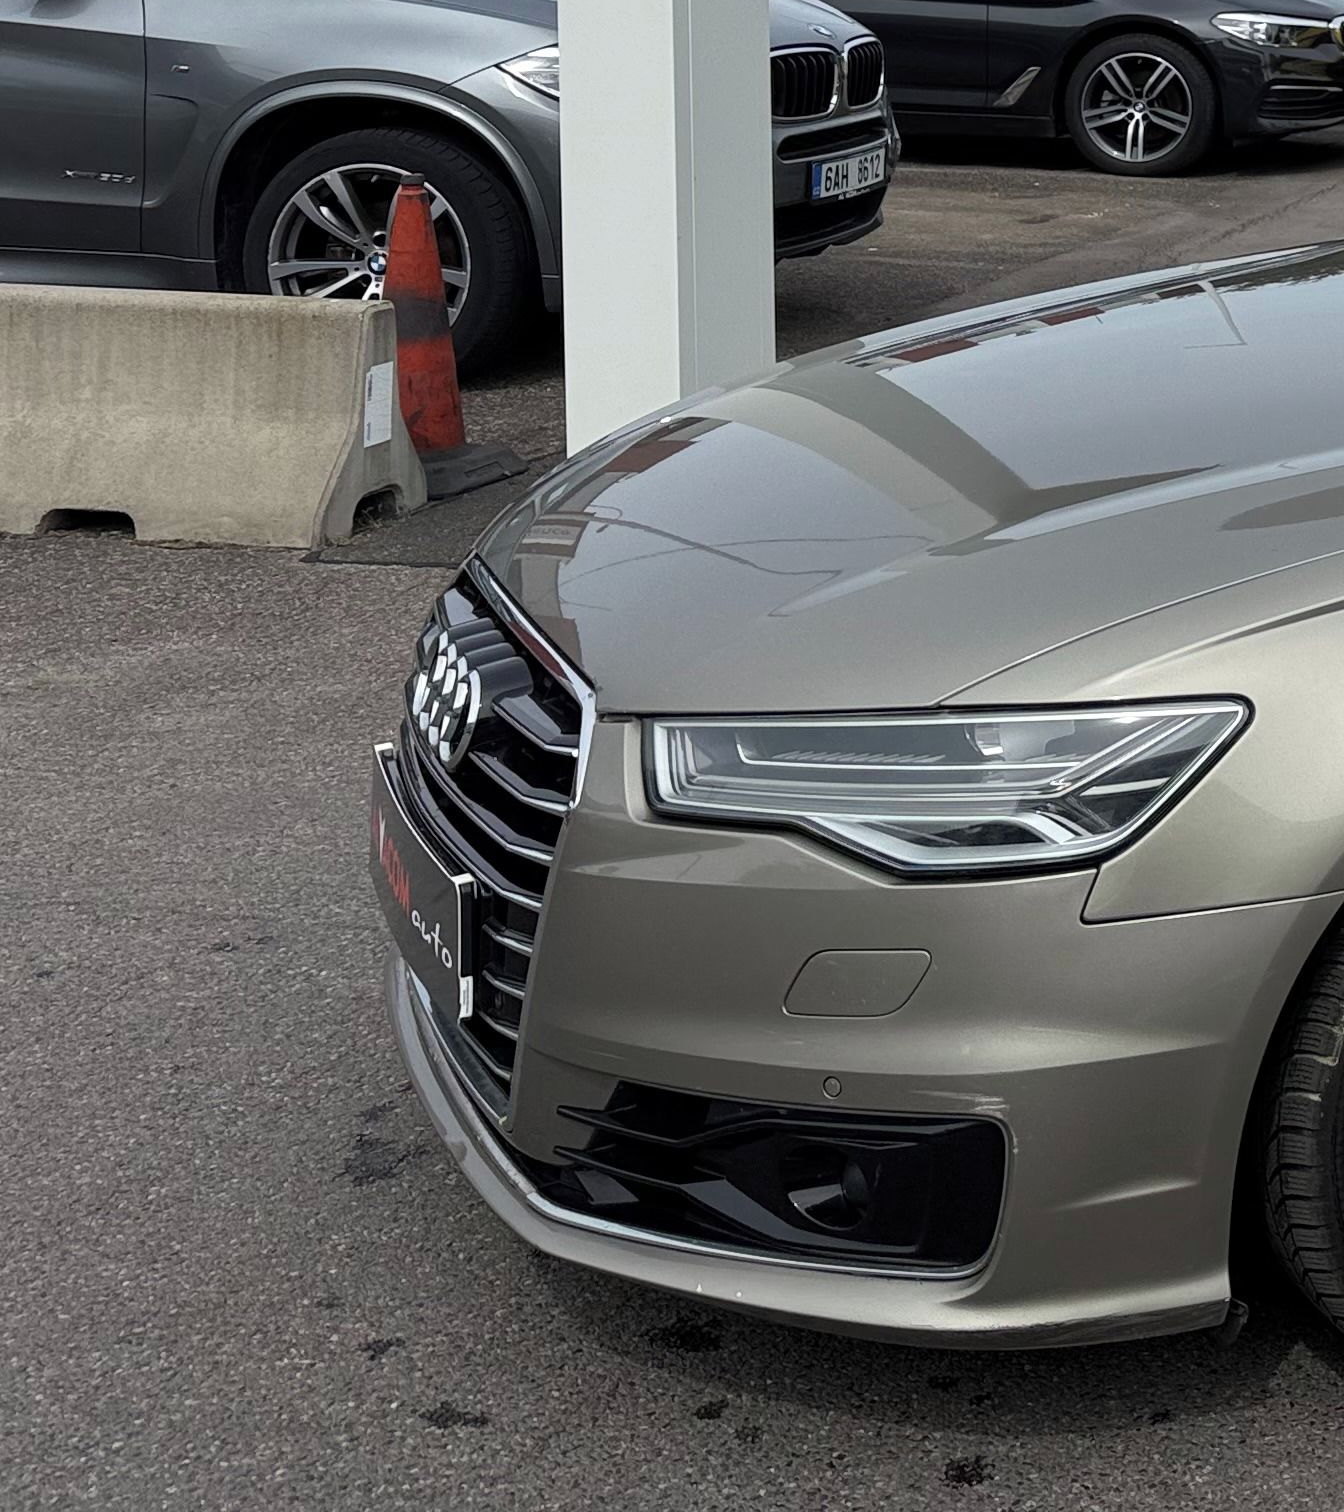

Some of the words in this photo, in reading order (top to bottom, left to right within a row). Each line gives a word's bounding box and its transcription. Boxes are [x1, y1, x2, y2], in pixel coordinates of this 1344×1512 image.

[825, 162, 849, 192] 6AH
[858, 153, 880, 185] 8612
[411, 910, 453, 970] auto
